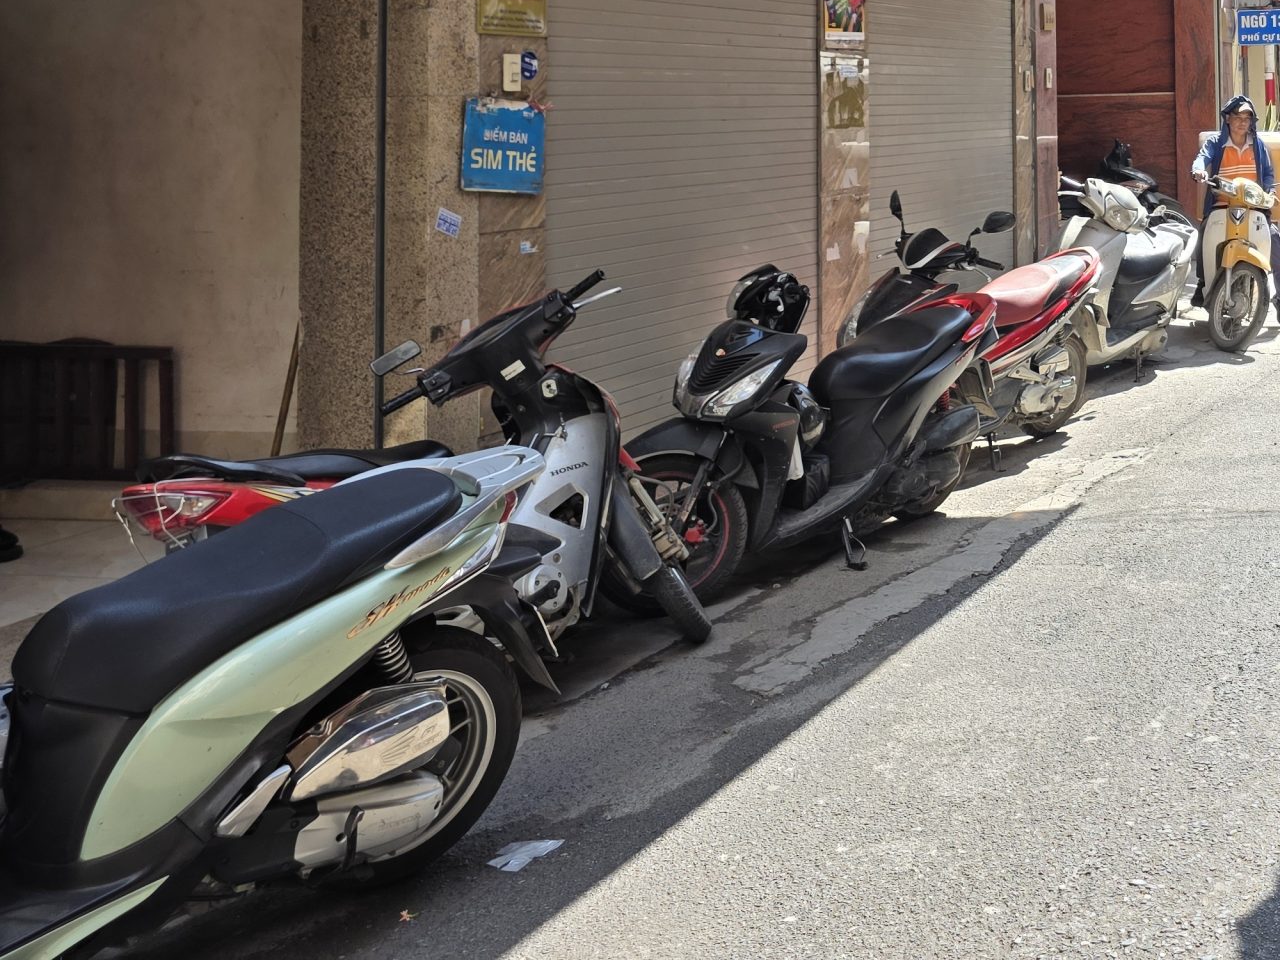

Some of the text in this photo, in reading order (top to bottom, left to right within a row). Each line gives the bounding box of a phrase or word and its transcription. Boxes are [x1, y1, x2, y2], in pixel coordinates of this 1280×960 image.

[1241, 12, 1268, 28] NGÕ
[1241, 32, 1260, 42] PHỐ
[1262, 33, 1275, 43] CỰ
[509, 130, 528, 144] BÁN
[470, 145, 537, 172] SIM THẺ
[550, 461, 589, 476] HONDA
